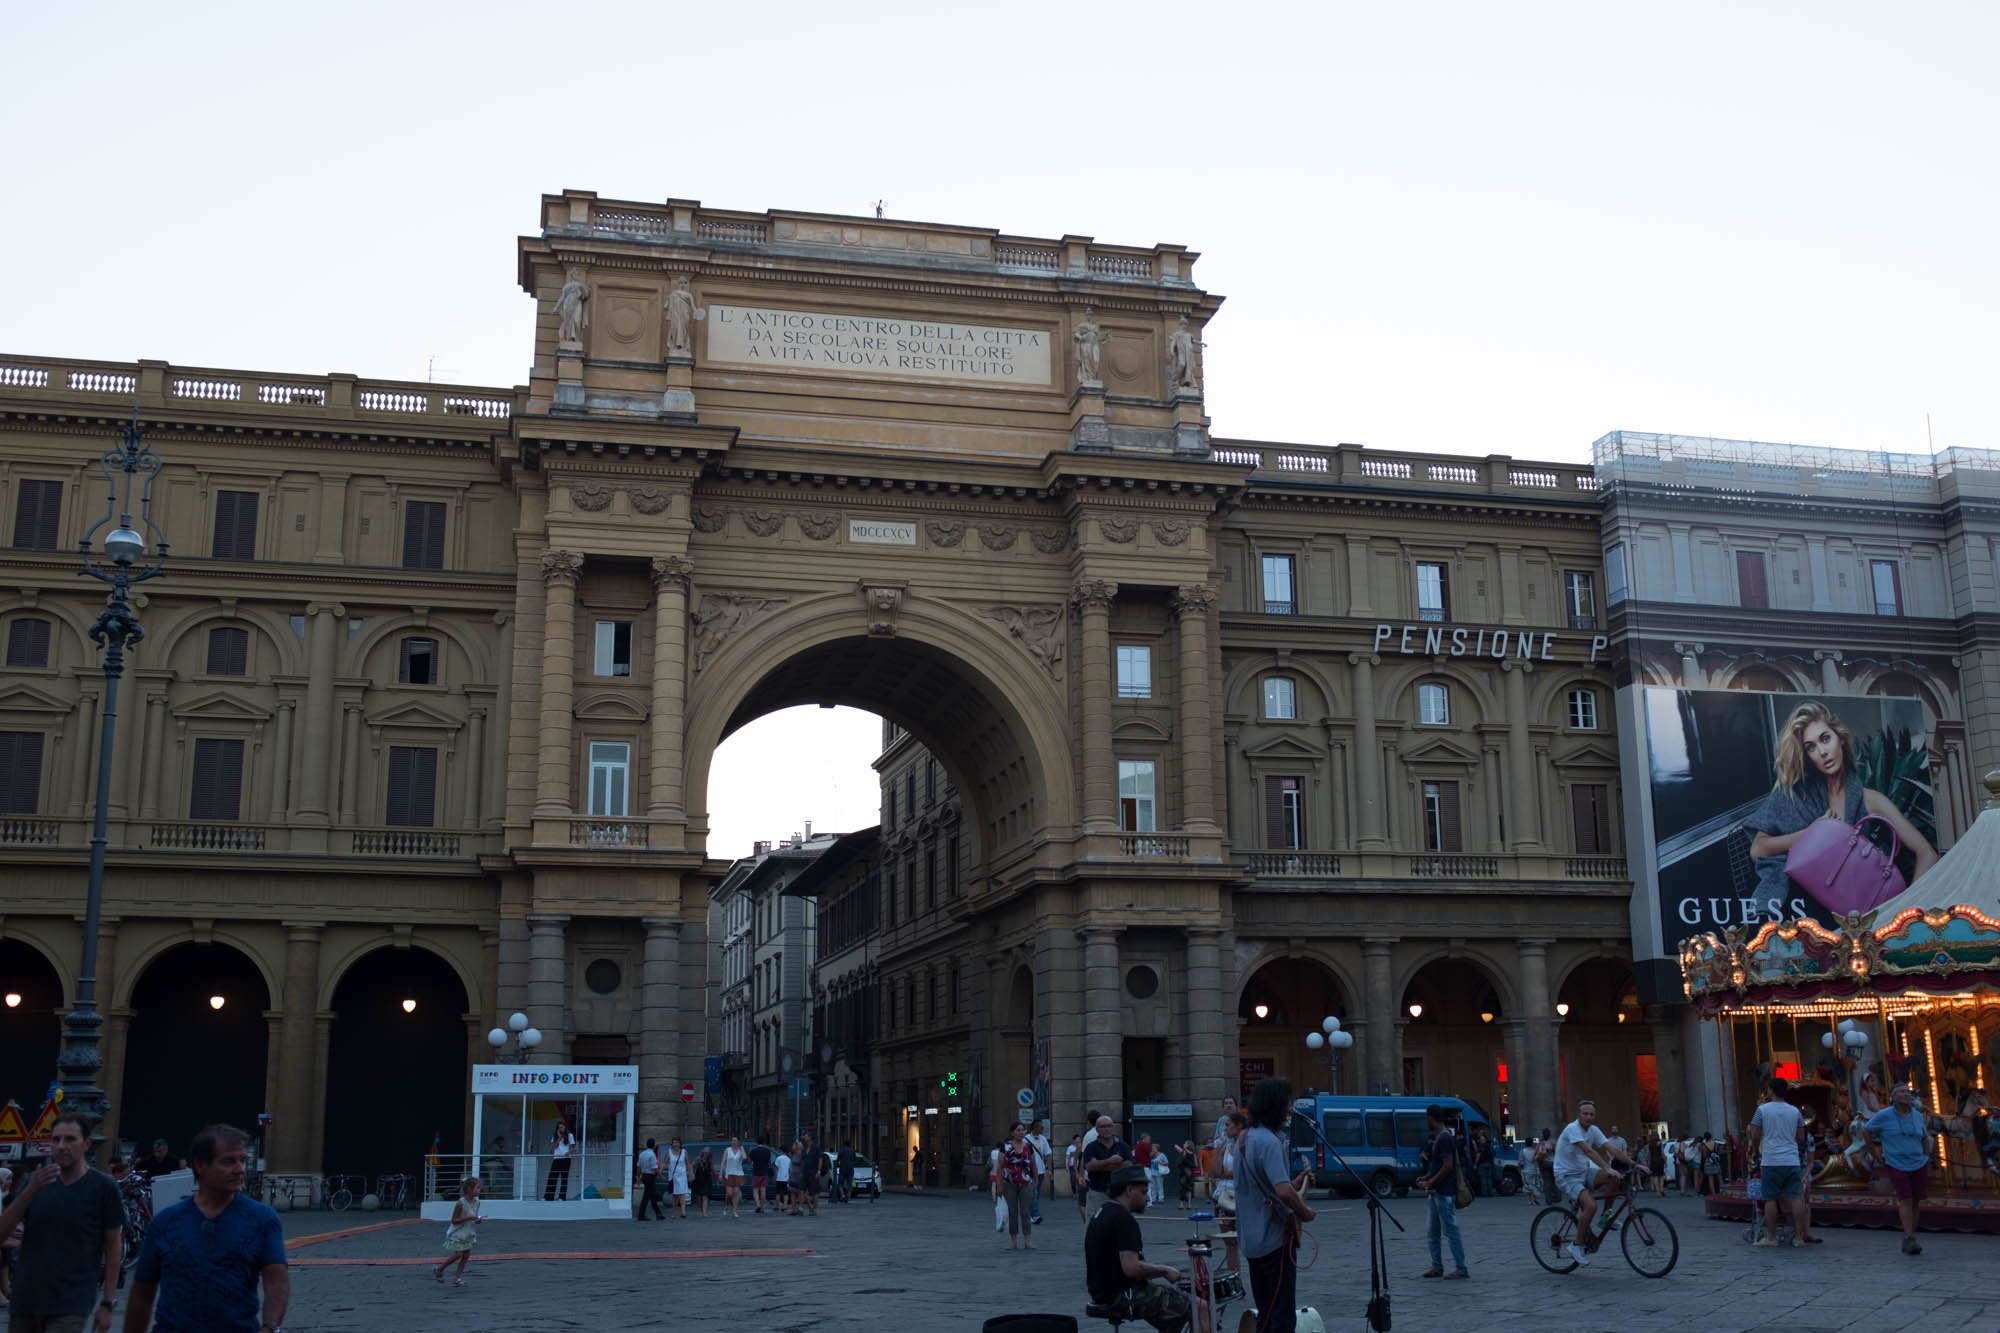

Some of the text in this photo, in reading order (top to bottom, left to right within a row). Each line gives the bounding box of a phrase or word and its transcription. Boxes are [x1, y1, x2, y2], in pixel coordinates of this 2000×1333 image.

[742, 312, 814, 329] ANTICO
[822, 318, 902, 336] CENTRO
[910, 324, 974, 342] DELLA
[748, 328, 1014, 361] DA SECOLARE SQUALLORE
[748, 345, 1014, 376] A VITA NUOVA RESTITUITO
[852, 526, 912, 539] MDCCCXCV
[1374, 624, 1558, 660] PENSIONE
[1678, 897, 1807, 925] GUESS
[512, 1073, 549, 1084] INFO
[552, 1073, 600, 1084] POINT
